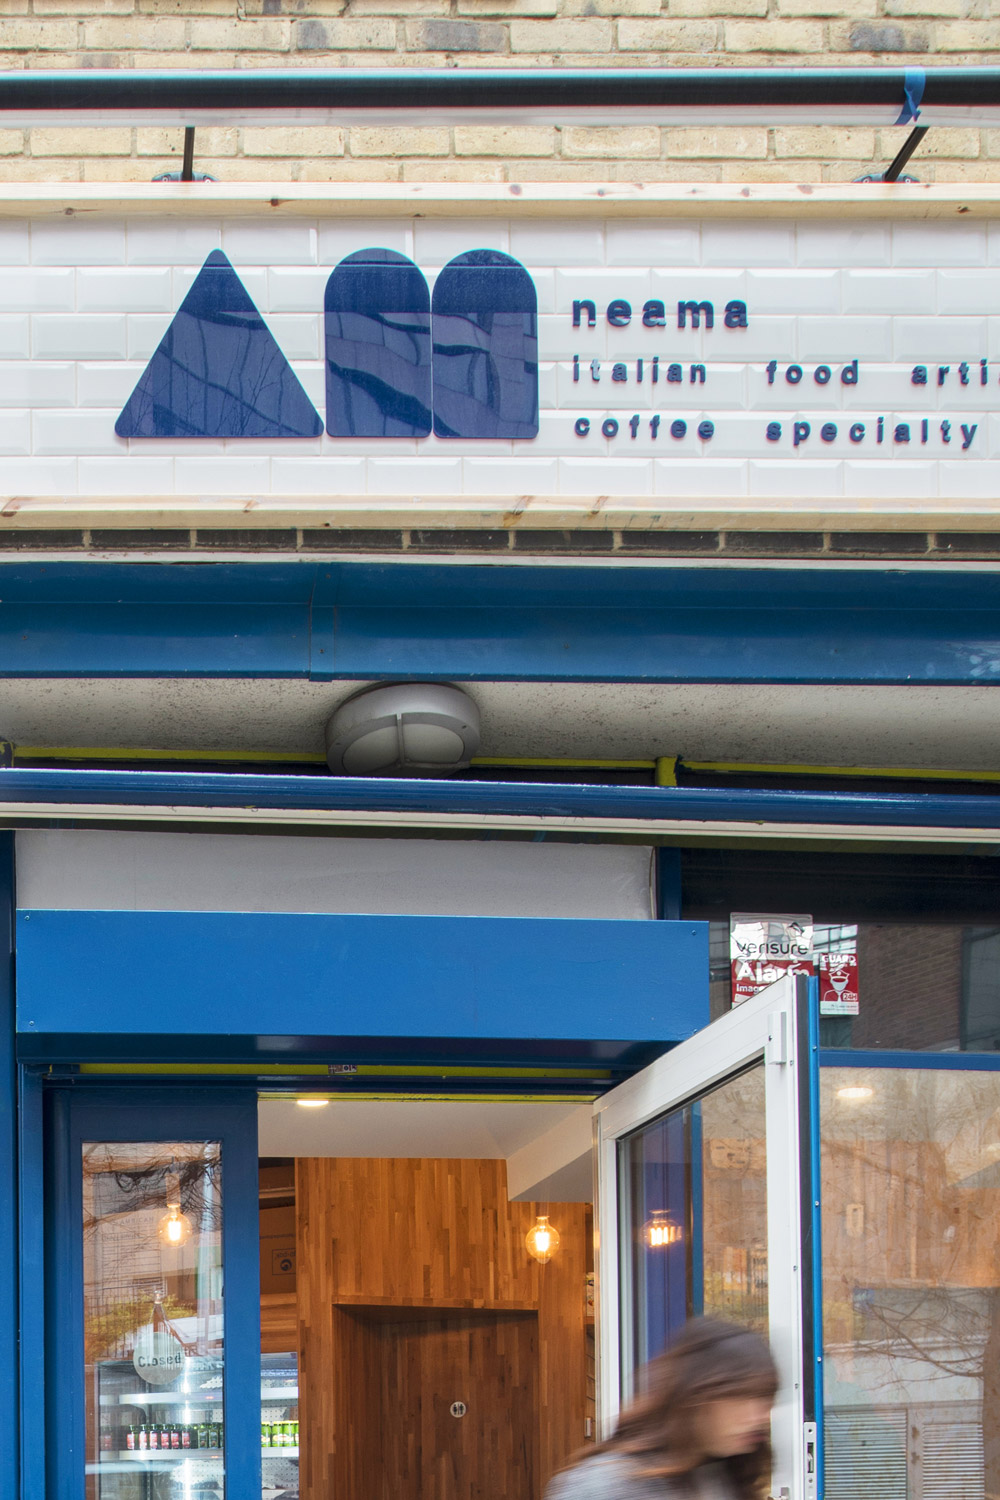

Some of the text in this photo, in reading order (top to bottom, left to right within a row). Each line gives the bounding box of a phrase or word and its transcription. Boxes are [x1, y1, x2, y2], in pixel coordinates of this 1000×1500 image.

[572, 299, 748, 328] neama
[573, 354, 1000, 385] italian food arti
[574, 414, 978, 448] coffee specialty
[736, 941, 809, 955] verisure
[821, 954, 857, 963] GUARD
